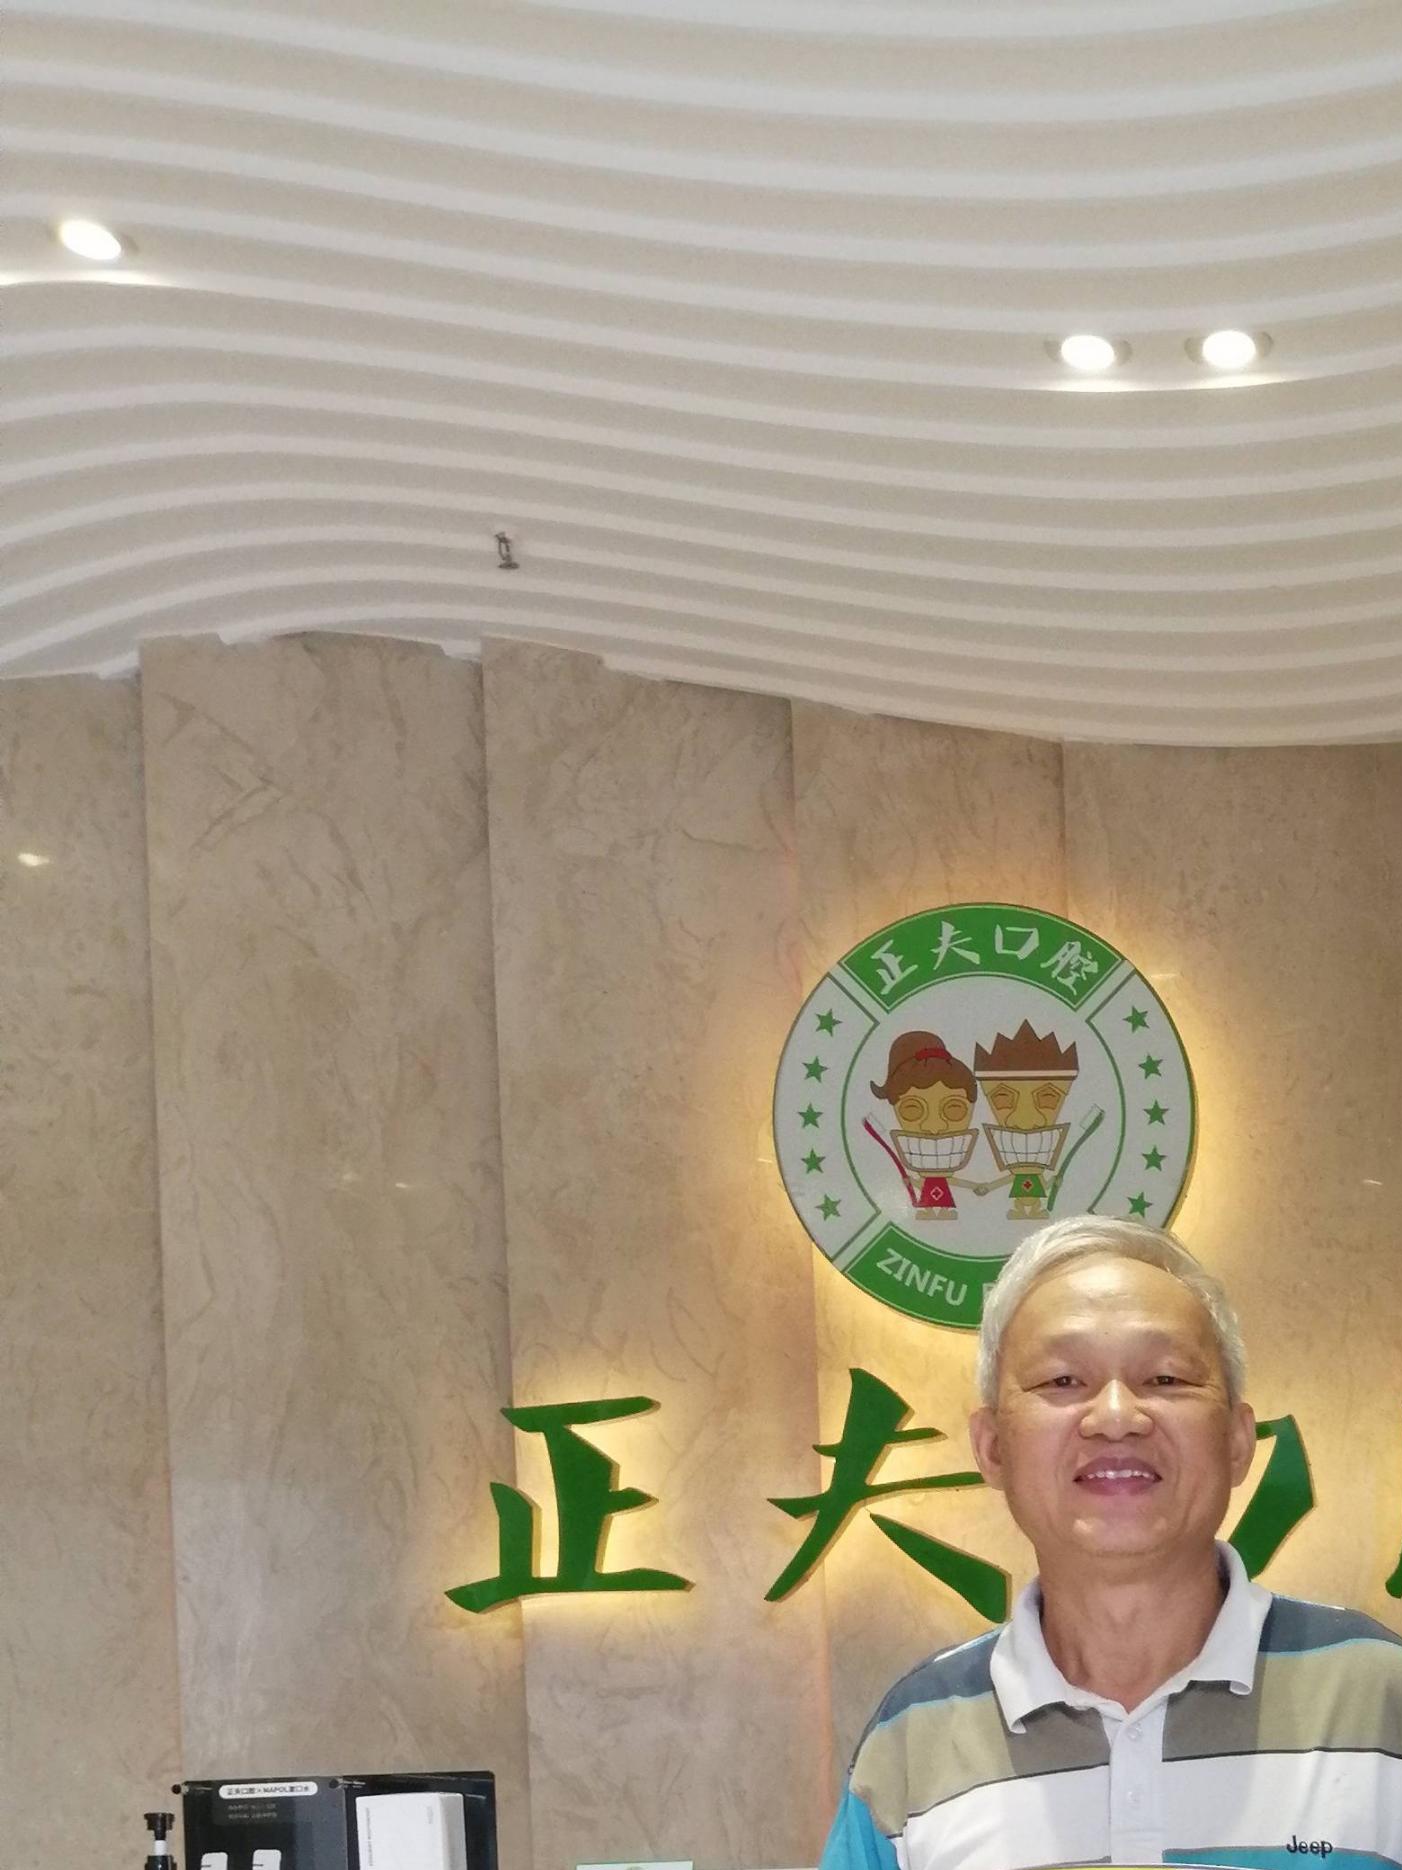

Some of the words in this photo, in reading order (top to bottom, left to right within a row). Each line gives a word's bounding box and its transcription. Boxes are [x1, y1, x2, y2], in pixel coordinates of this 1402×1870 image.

[870, 920, 1098, 995] 正夫口腔
[876, 1247, 968, 1306] ZINFU
[1286, 1834, 1333, 1859] Jeep
